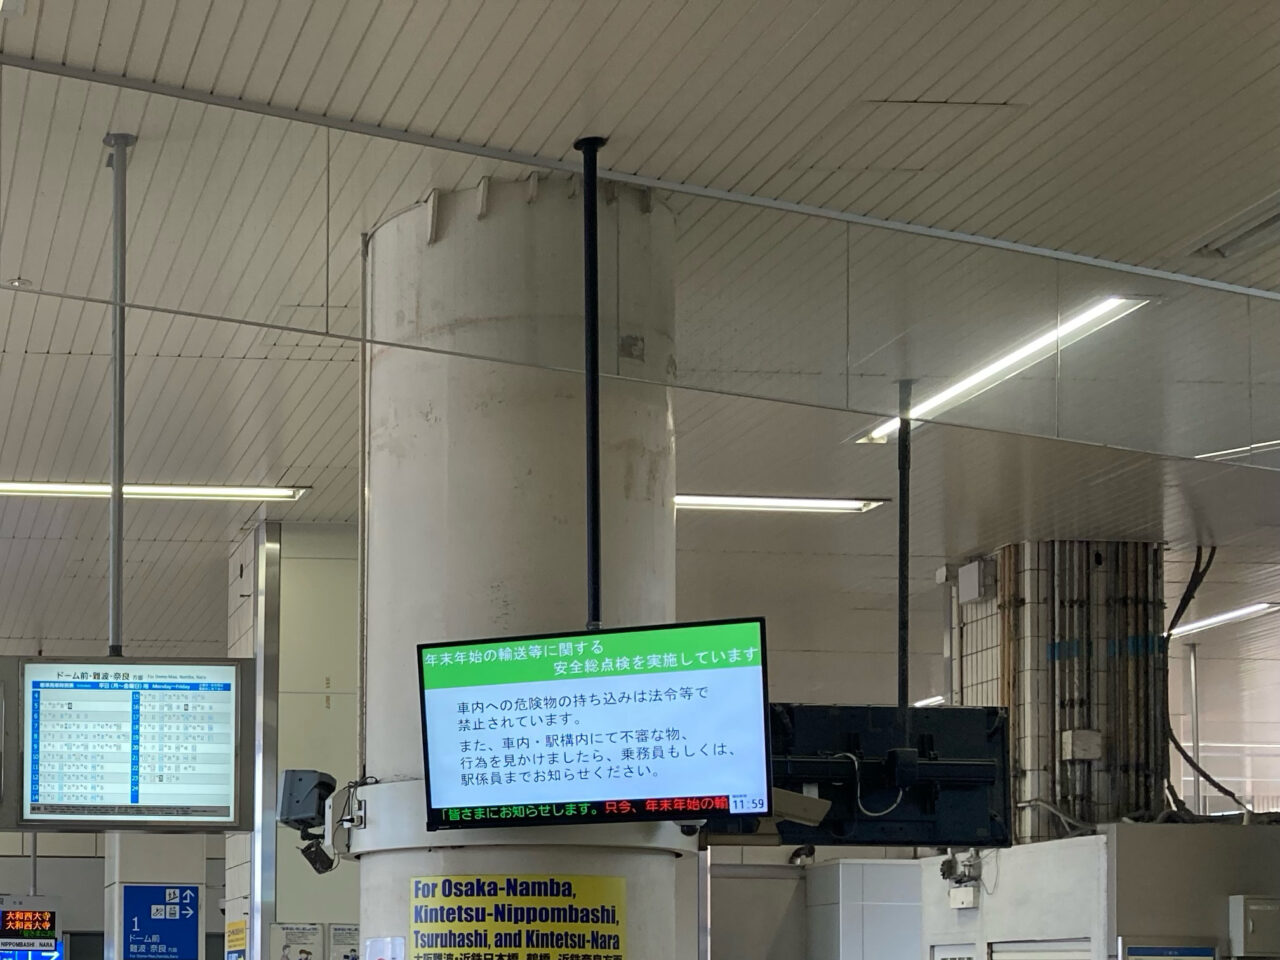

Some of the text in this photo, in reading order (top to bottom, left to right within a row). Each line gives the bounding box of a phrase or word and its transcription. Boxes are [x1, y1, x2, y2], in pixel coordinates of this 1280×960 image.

[424, 639, 604, 666] 年末年始の輸送等に関する
[553, 646, 759, 676] 安全総点検を実施しています
[457, 685, 710, 714] 車内への危険物の持ち込みは法令等で
[458, 712, 581, 732] 禁止されています。
[460, 727, 688, 753] また、車内・駅構内にて不審な物、
[460, 743, 736, 770] 行為を見かけましたら、乗務員もしくは、
[461, 765, 659, 787] 駅係員までお知らせください。
[732, 797, 766, 811] 11:59
[414, 878, 577, 900] For Osaka-Namba,
[132, 916, 140, 931] 1
[414, 903, 620, 926] Kintetsu-Nippombashi,
[414, 929, 620, 950] Tsuruhashi, and Kintetsu-Nara
